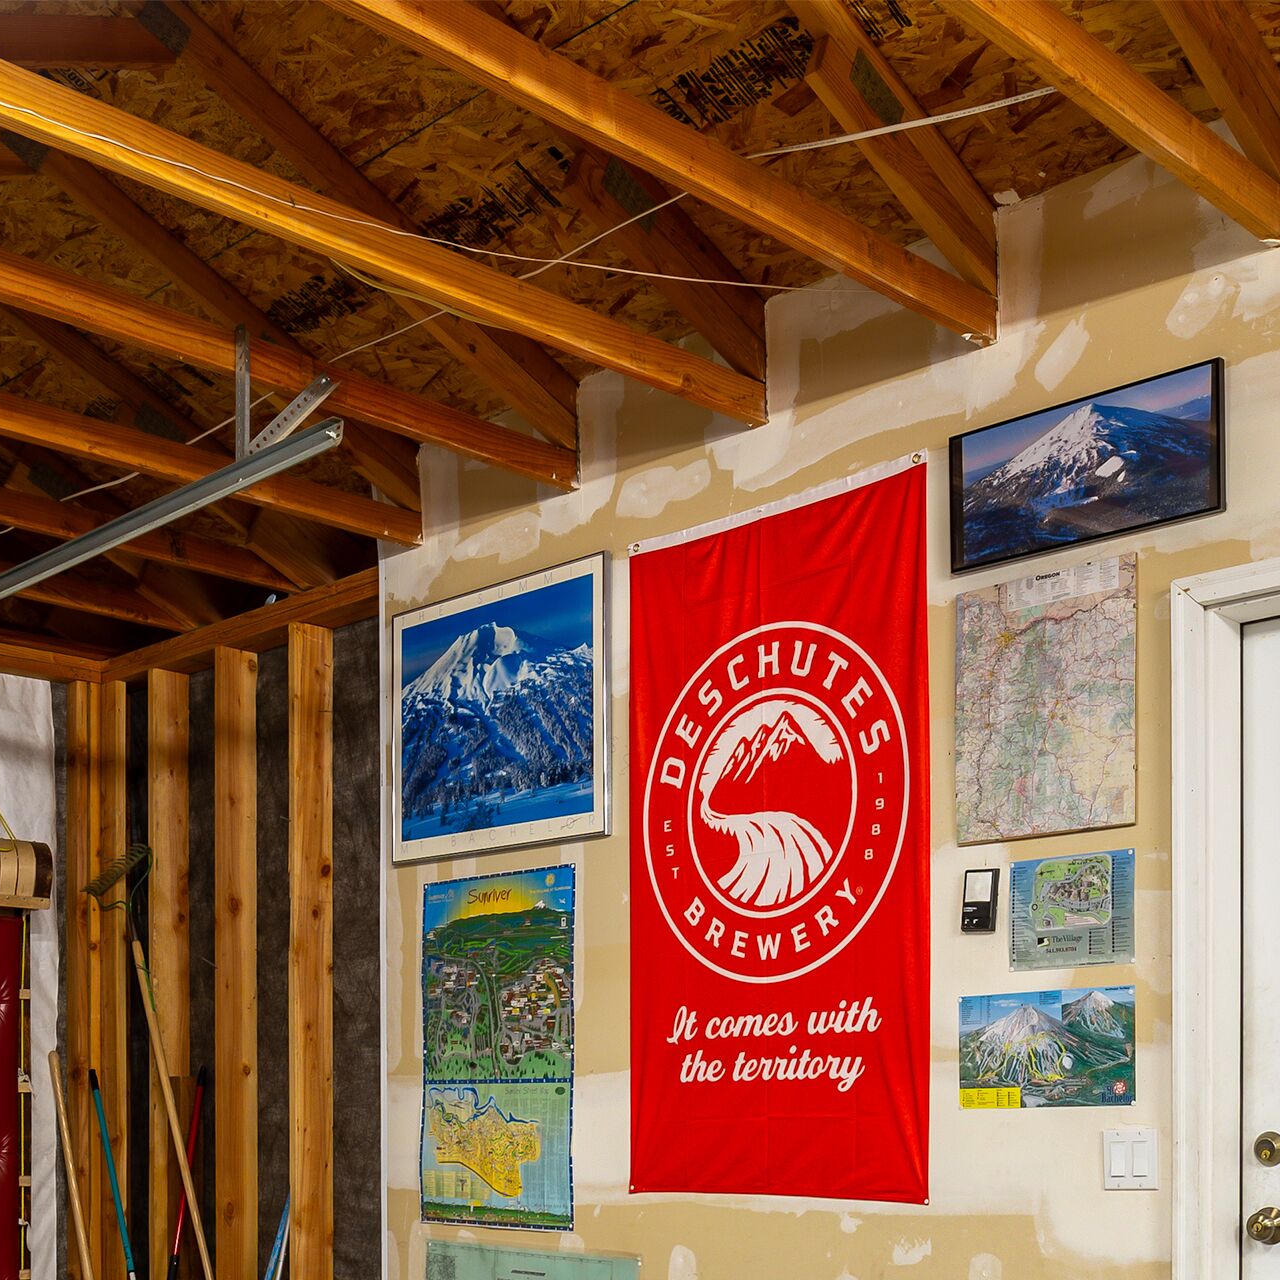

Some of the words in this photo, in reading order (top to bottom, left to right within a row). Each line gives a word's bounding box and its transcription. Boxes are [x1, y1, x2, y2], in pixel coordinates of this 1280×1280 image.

[1035, 571, 1061, 581] OREGON
[659, 640, 892, 789] DESCHUTES
[663, 819, 680, 880] EST
[467, 888, 512, 904] Sunriver
[683, 878, 858, 961] BREWERY
[666, 1005, 698, 1045] It
[705, 1008, 798, 1040] comes
[808, 996, 882, 1036] with
[680, 1049, 725, 1083] the
[732, 1045, 866, 1093] territory
